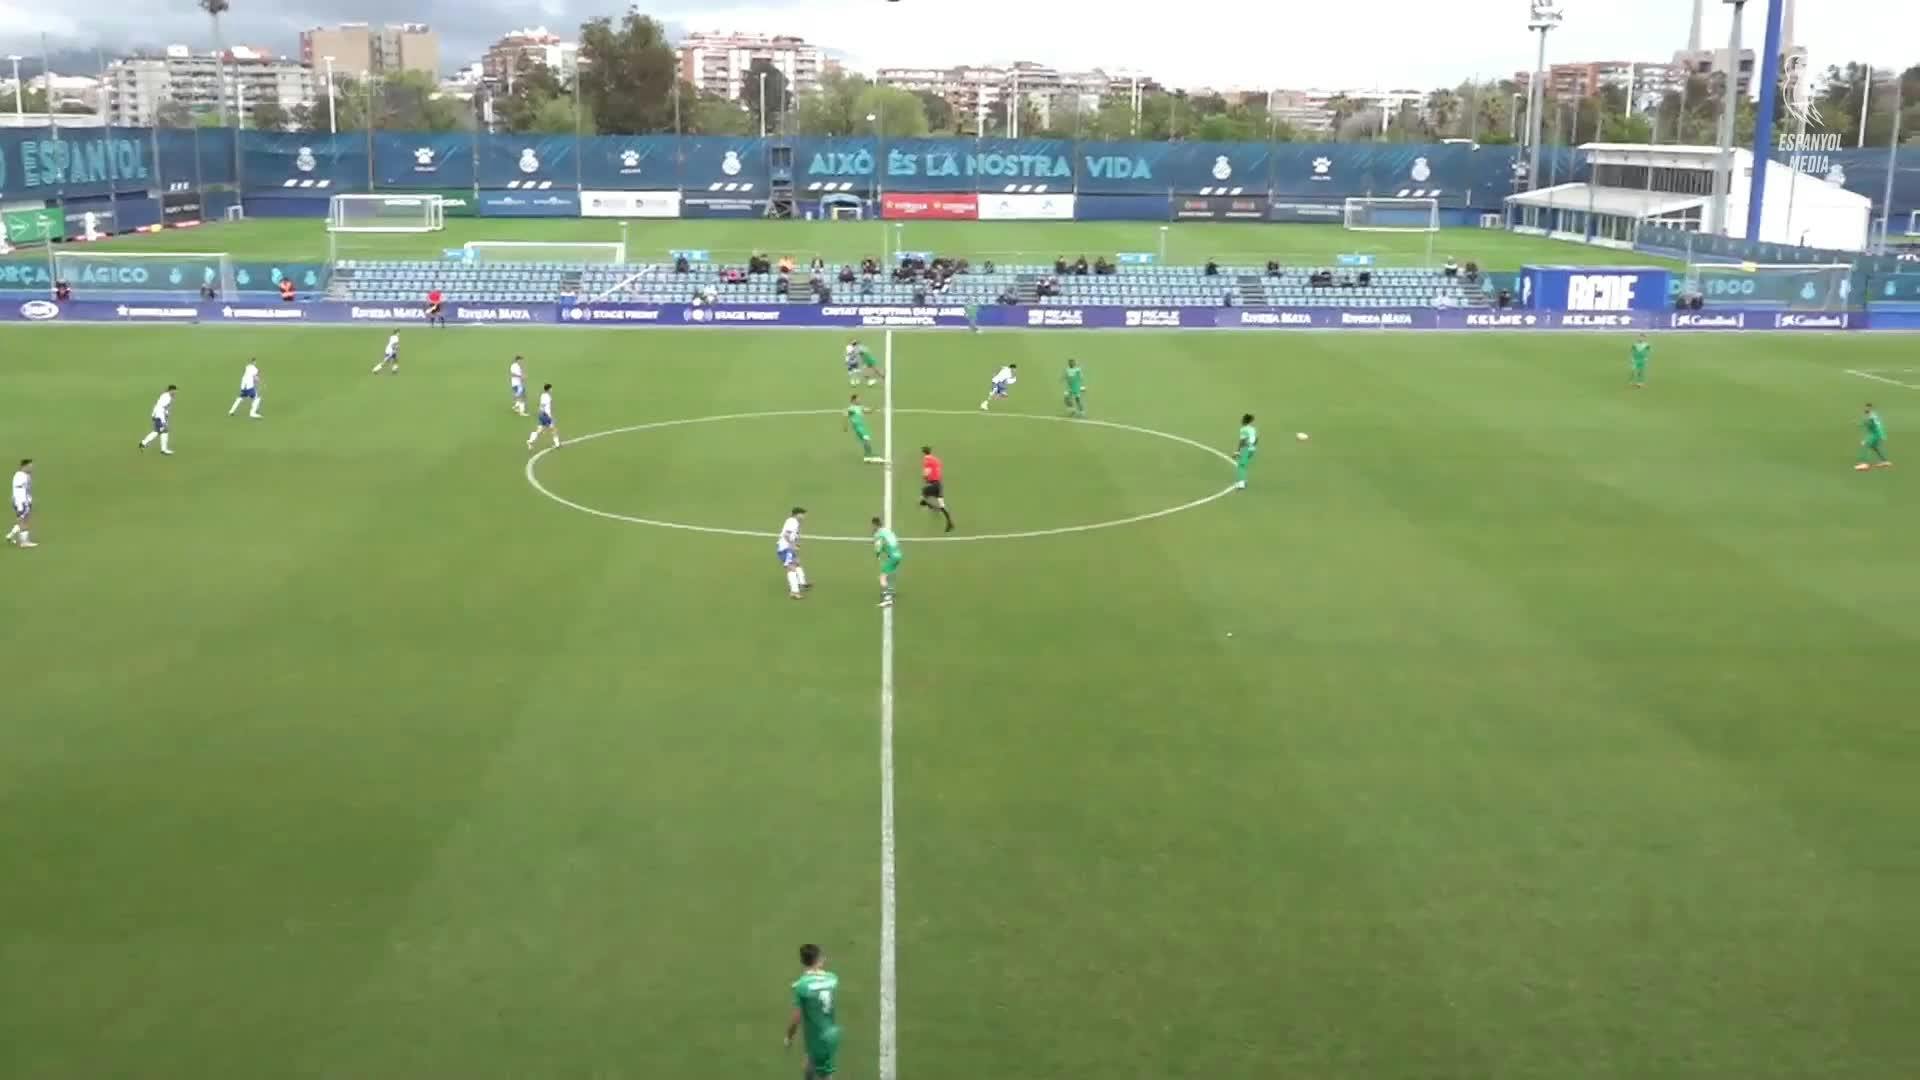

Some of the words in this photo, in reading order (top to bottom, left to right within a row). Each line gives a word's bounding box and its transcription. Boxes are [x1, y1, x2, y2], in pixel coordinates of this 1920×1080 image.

[21, 139, 148, 187] ESPANYOL
[926, 153, 960, 176] LA
[966, 154, 1071, 177] NOSTRA
[1086, 156, 1152, 178] VIDA
[1467, 314, 1522, 325] KELME
[1562, 315, 1616, 325] KELME
